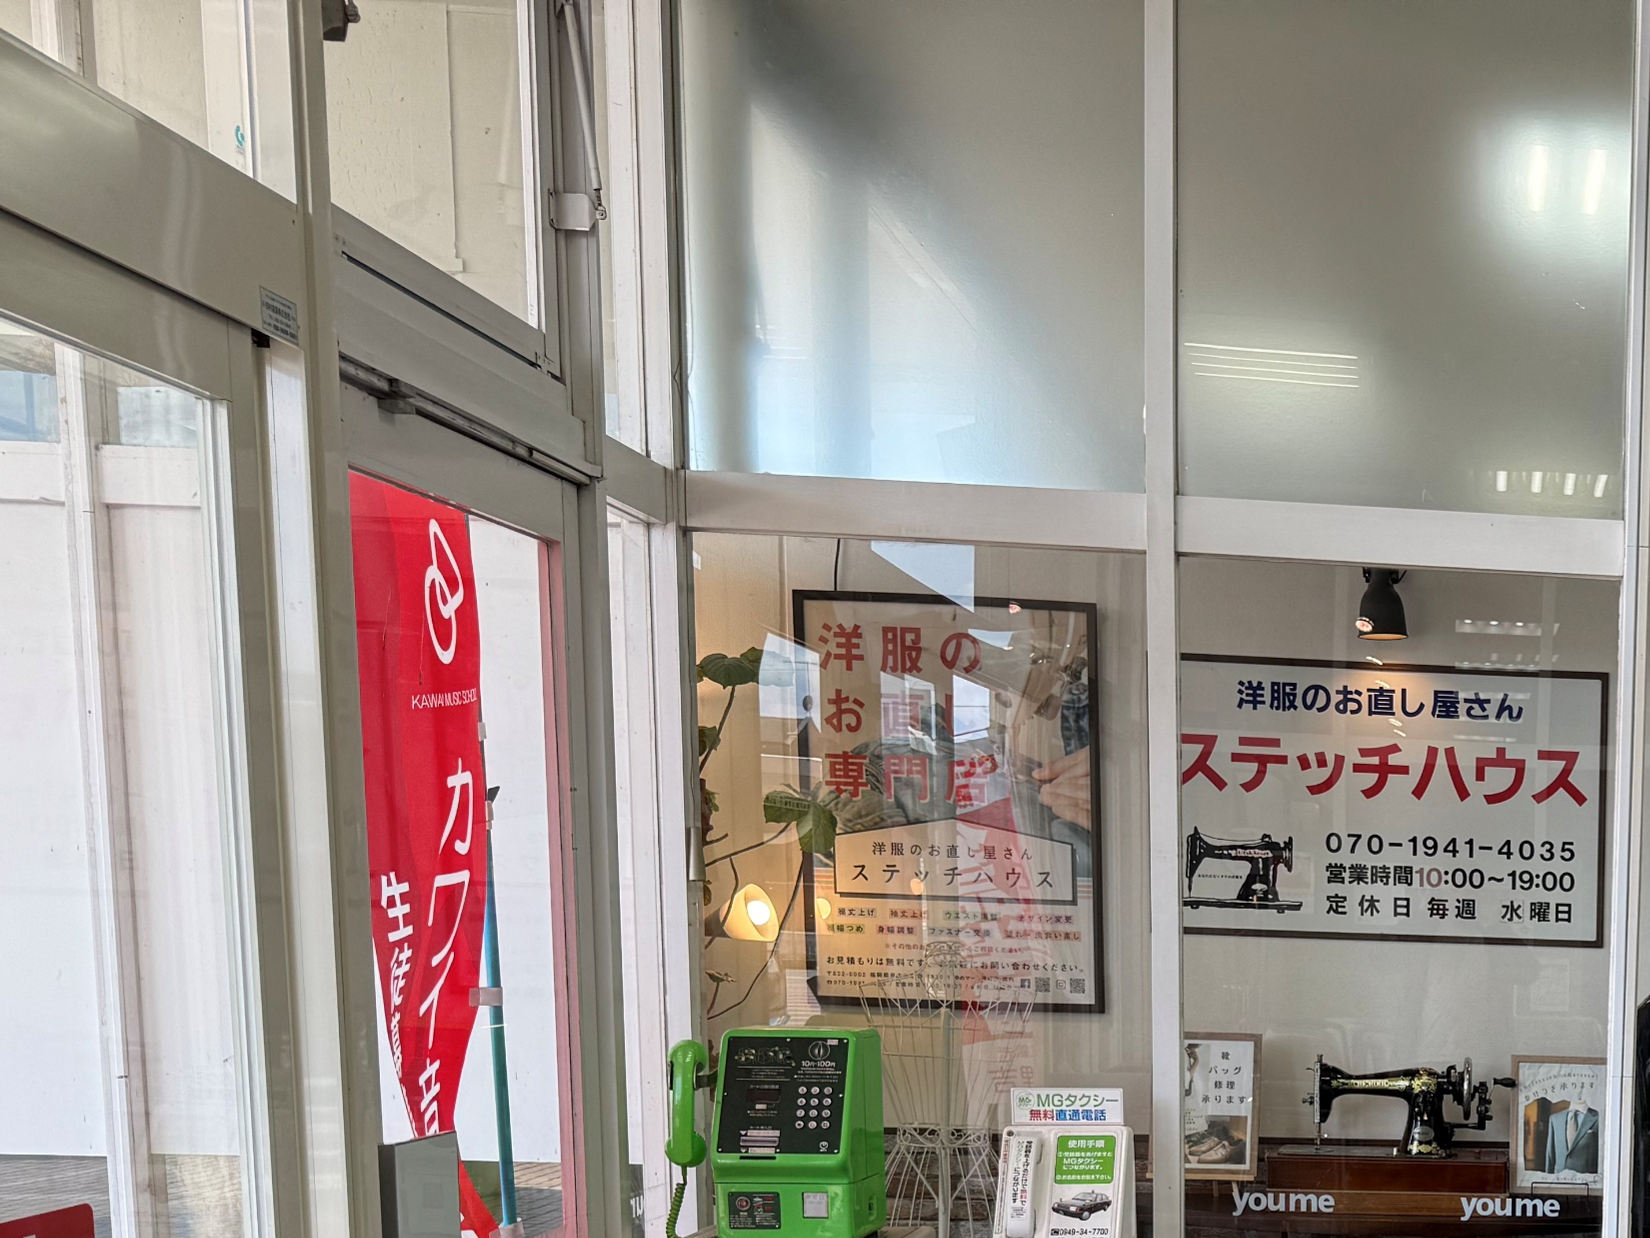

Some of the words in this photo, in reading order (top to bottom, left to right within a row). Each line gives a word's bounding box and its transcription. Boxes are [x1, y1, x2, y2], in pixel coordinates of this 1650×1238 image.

[820, 622, 981, 673] 洋服の
[1237, 680, 1523, 722] 洋服のお直し屋さん
[1181, 734, 1588, 807] ステッチハウス
[872, 841, 1033, 861] 洋服のお直し屋さん
[1326, 832, 1575, 861] 070-1941-4035
[852, 864, 1054, 888] ステッチハウス
[1209, 1066, 1241, 1075] バッグ
[1214, 1081, 1235, 1089] 修理
[1037, 1094, 1119, 1107] MGタクシー
[1201, 1095, 1246, 1104] 承ります
[1029, 1109, 1107, 1121] 無料直通電話
[1233, 1188, 1335, 1216] youme
[1461, 1195, 1561, 1221] youme
